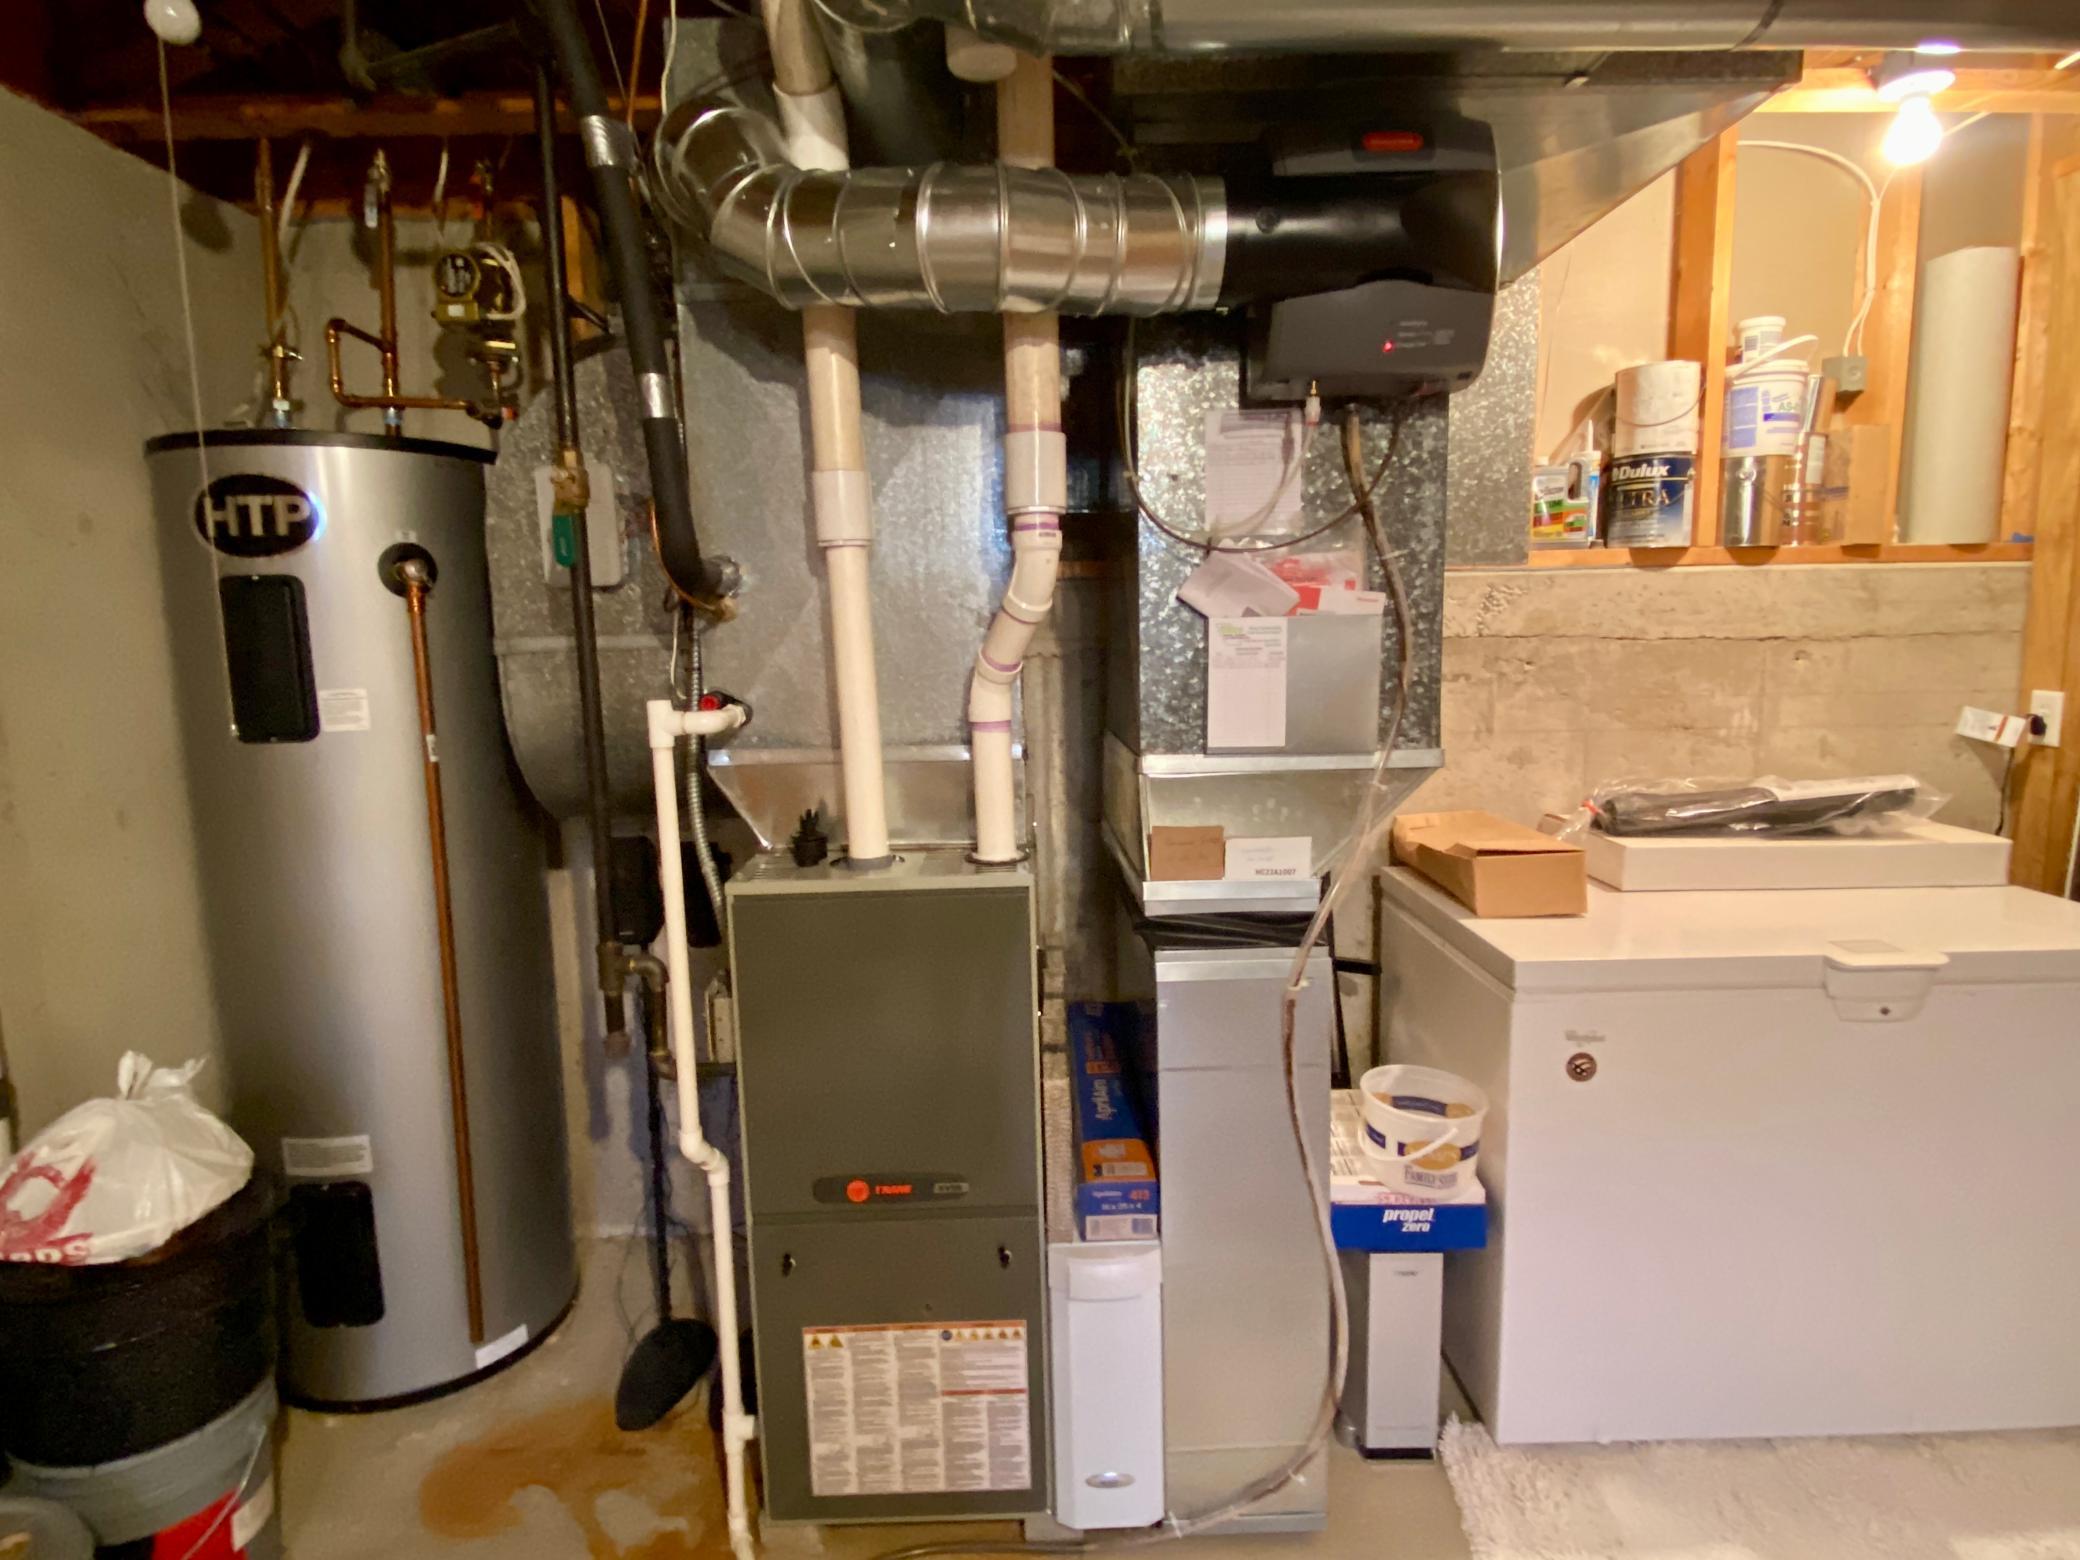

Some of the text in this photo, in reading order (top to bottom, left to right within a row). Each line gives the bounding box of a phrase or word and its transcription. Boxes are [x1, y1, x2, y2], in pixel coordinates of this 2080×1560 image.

[1619, 464, 1671, 480] Dulux
[202, 494, 311, 537] HTP
[1382, 1208, 1435, 1223] propel
[1401, 1222, 1431, 1232] zero
